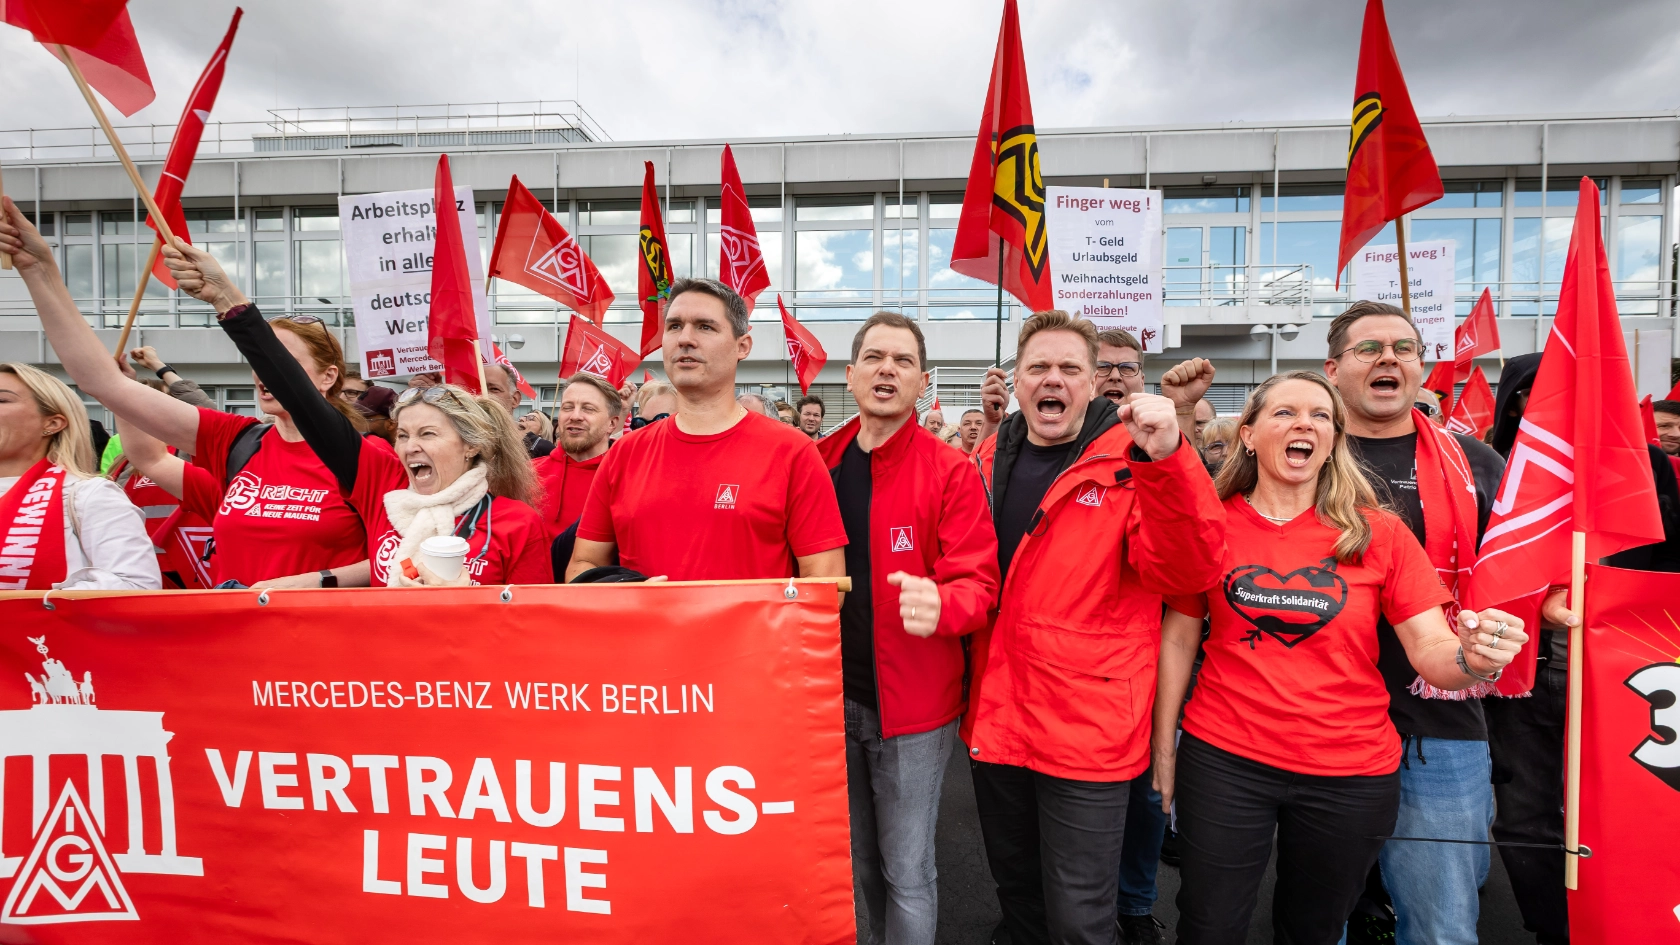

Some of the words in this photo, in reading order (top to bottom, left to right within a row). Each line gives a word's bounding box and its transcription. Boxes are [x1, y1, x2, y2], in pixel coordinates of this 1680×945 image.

[351, 198, 466, 221] Arbeitsplz
[1056, 195, 1105, 212] Finger
[1109, 199, 1141, 213] weg
[1146, 197, 1151, 210] !
[382, 225, 437, 245] erhalt
[1086, 236, 1097, 246] T-
[1099, 236, 1124, 247] Geld
[379, 257, 396, 271] in
[403, 252, 434, 270] alle
[1072, 252, 1138, 264] Urlaubsgeld
[1365, 252, 1400, 263] Finge
[1409, 249, 1437, 260] weg
[1442, 247, 1446, 257] !
[1061, 273, 1148, 286] Weihnachtsgeld
[1408, 278, 1422, 287] eld
[371, 291, 431, 310] deutsc
[1058, 289, 1152, 302] Sonderzahlungen
[1377, 289, 1433, 300] Urlausgeld
[1083, 304, 1128, 316] bleiben!
[399, 354, 434, 364] Mercede
[407, 365, 427, 373] Werk
[429, 363, 445, 371] Berl
[260, 484, 329, 503] REICHT
[264, 503, 286, 511] KEINE
[286, 504, 304, 512] ZEIT
[304, 505, 322, 514] FÜR
[262, 511, 282, 519] NEUE
[283, 511, 320, 522] MAUERN
[1234, 587, 1281, 605] Superkraft
[1281, 595, 1330, 611] Solidarität
[252, 680, 494, 710] MERCEDES-BENZ
[504, 682, 592, 713] WERK
[601, 683, 715, 715] BERLIN
[204, 747, 796, 836] VERTRAUENS-
[362, 829, 613, 915] LEUTE
